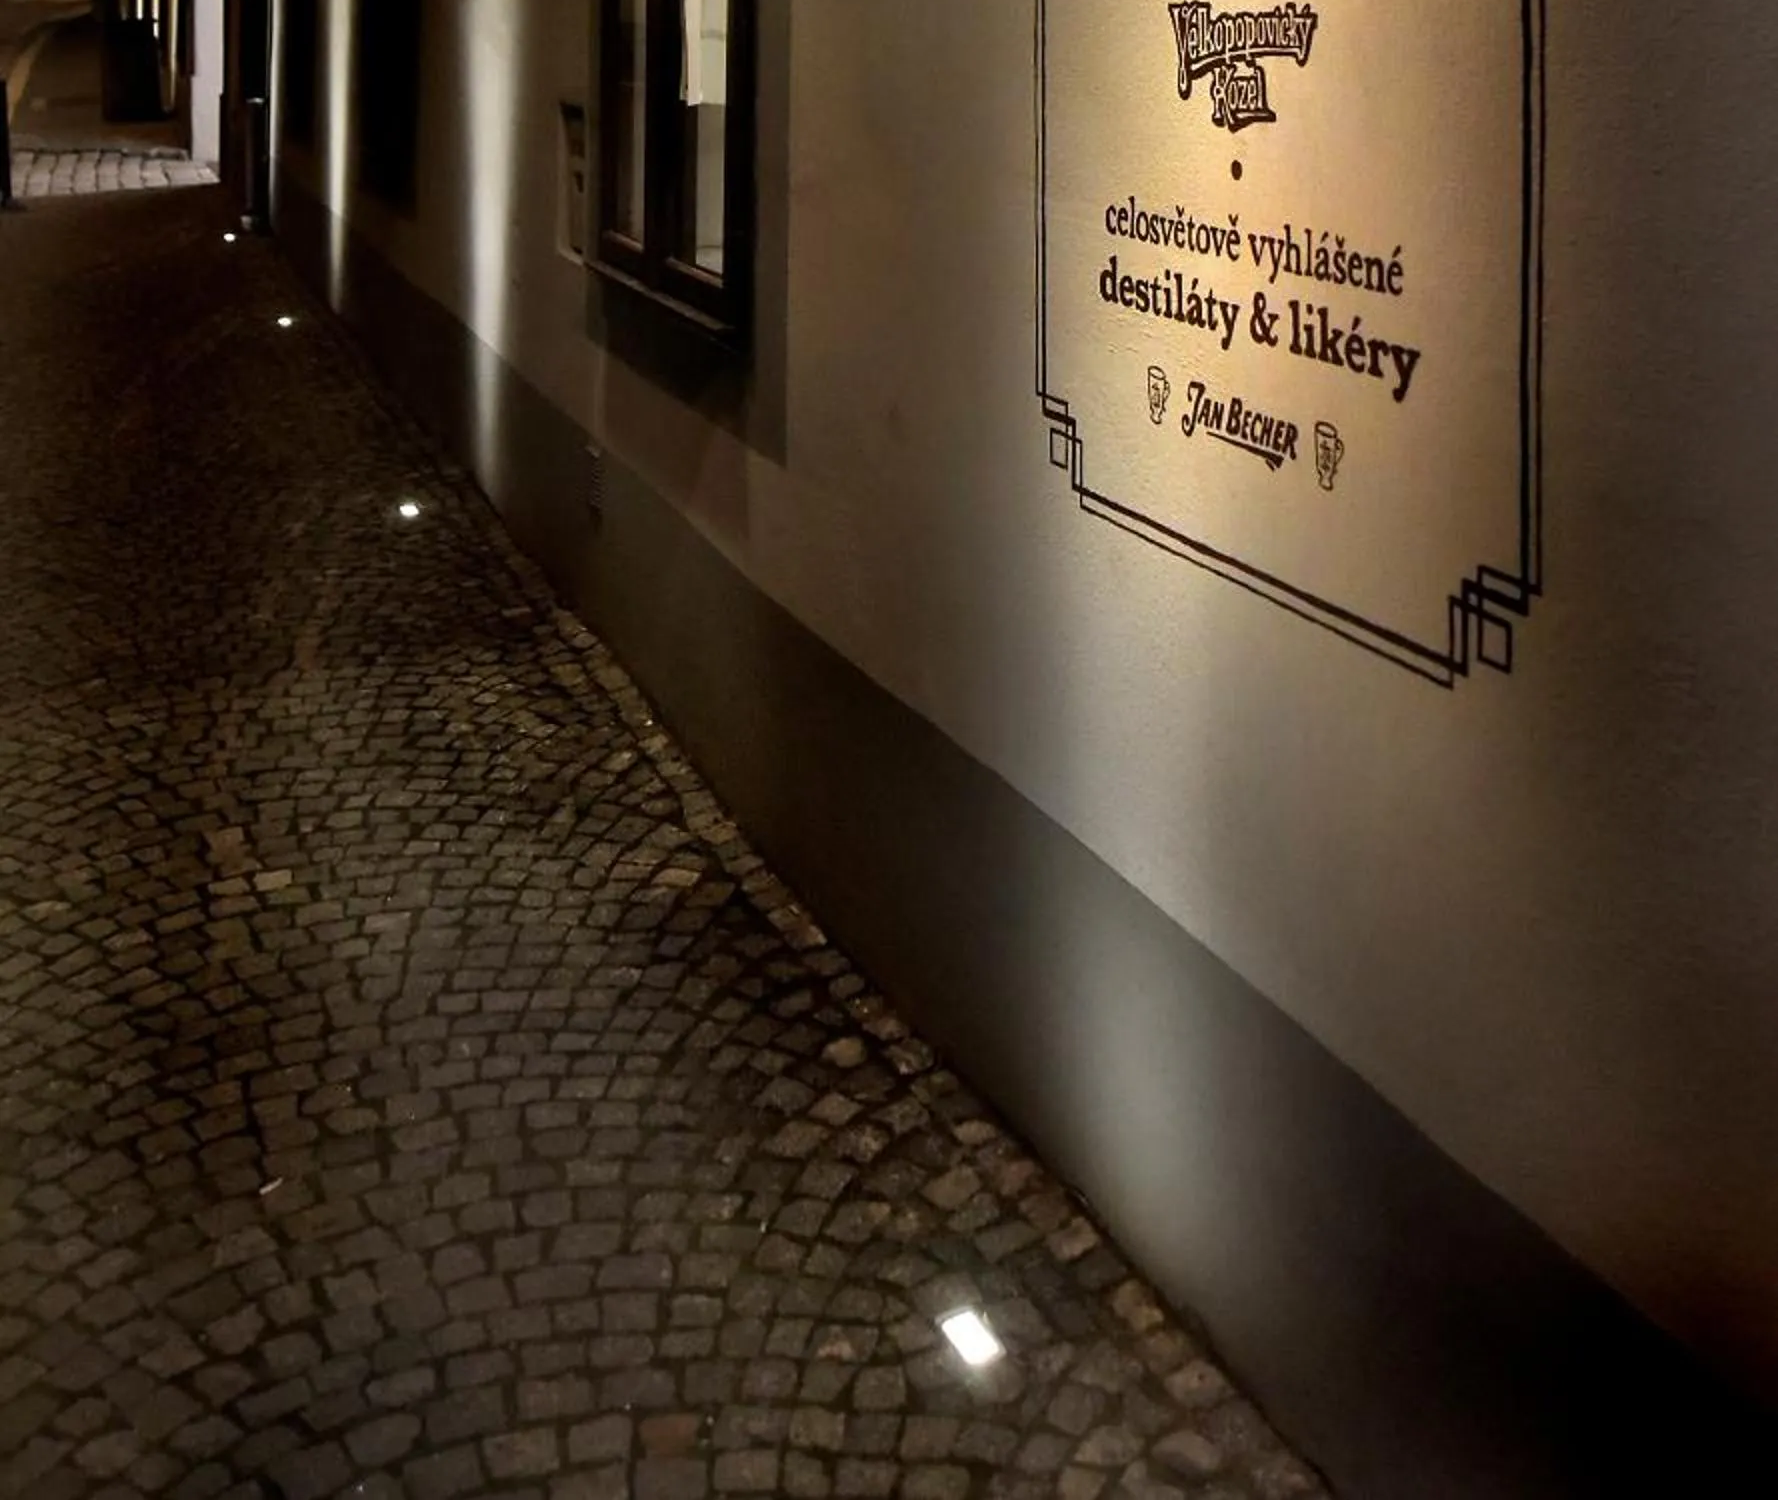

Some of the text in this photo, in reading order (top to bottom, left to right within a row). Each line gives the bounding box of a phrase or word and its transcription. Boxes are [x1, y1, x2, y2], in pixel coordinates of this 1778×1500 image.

[1168, 0, 1318, 100] Velkopopovický
[1210, 64, 1276, 133] Kozel
[1105, 196, 1404, 296] celosvětově vyhlášené
[1100, 255, 1421, 403] destiláty & likéry
[1181, 381, 1299, 459] JAN BECHER
